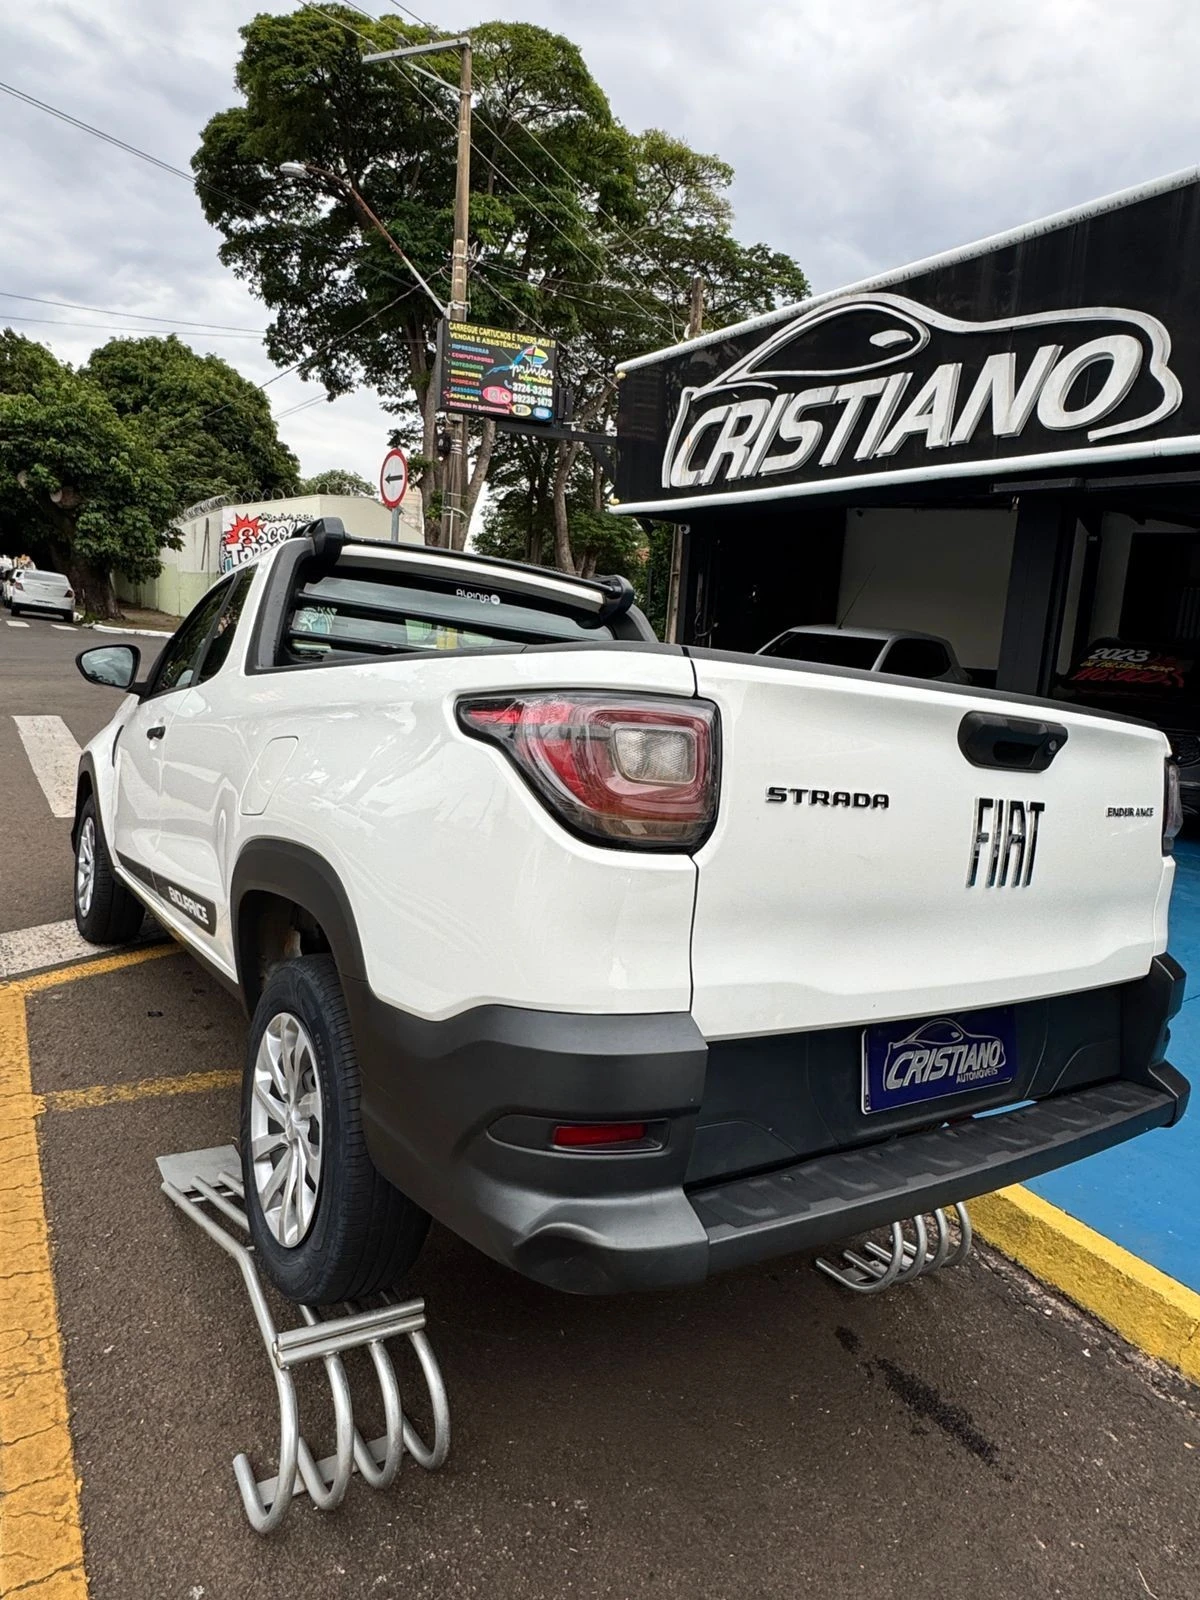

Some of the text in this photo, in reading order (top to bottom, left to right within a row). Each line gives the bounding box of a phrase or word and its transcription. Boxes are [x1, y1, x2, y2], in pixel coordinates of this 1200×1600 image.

[448, 322, 479, 335] CARREGUE
[512, 333, 516, 341] E
[449, 332, 475, 342] VENDAS
[670, 334, 1144, 488] CRISTIANO
[1088, 648, 1151, 662] 2023
[766, 786, 890, 809] STRADA
[1105, 806, 1154, 818] ENDURANCE
[965, 797, 1046, 889] FIAT
[886, 1040, 1002, 1090] CRISTIANO
